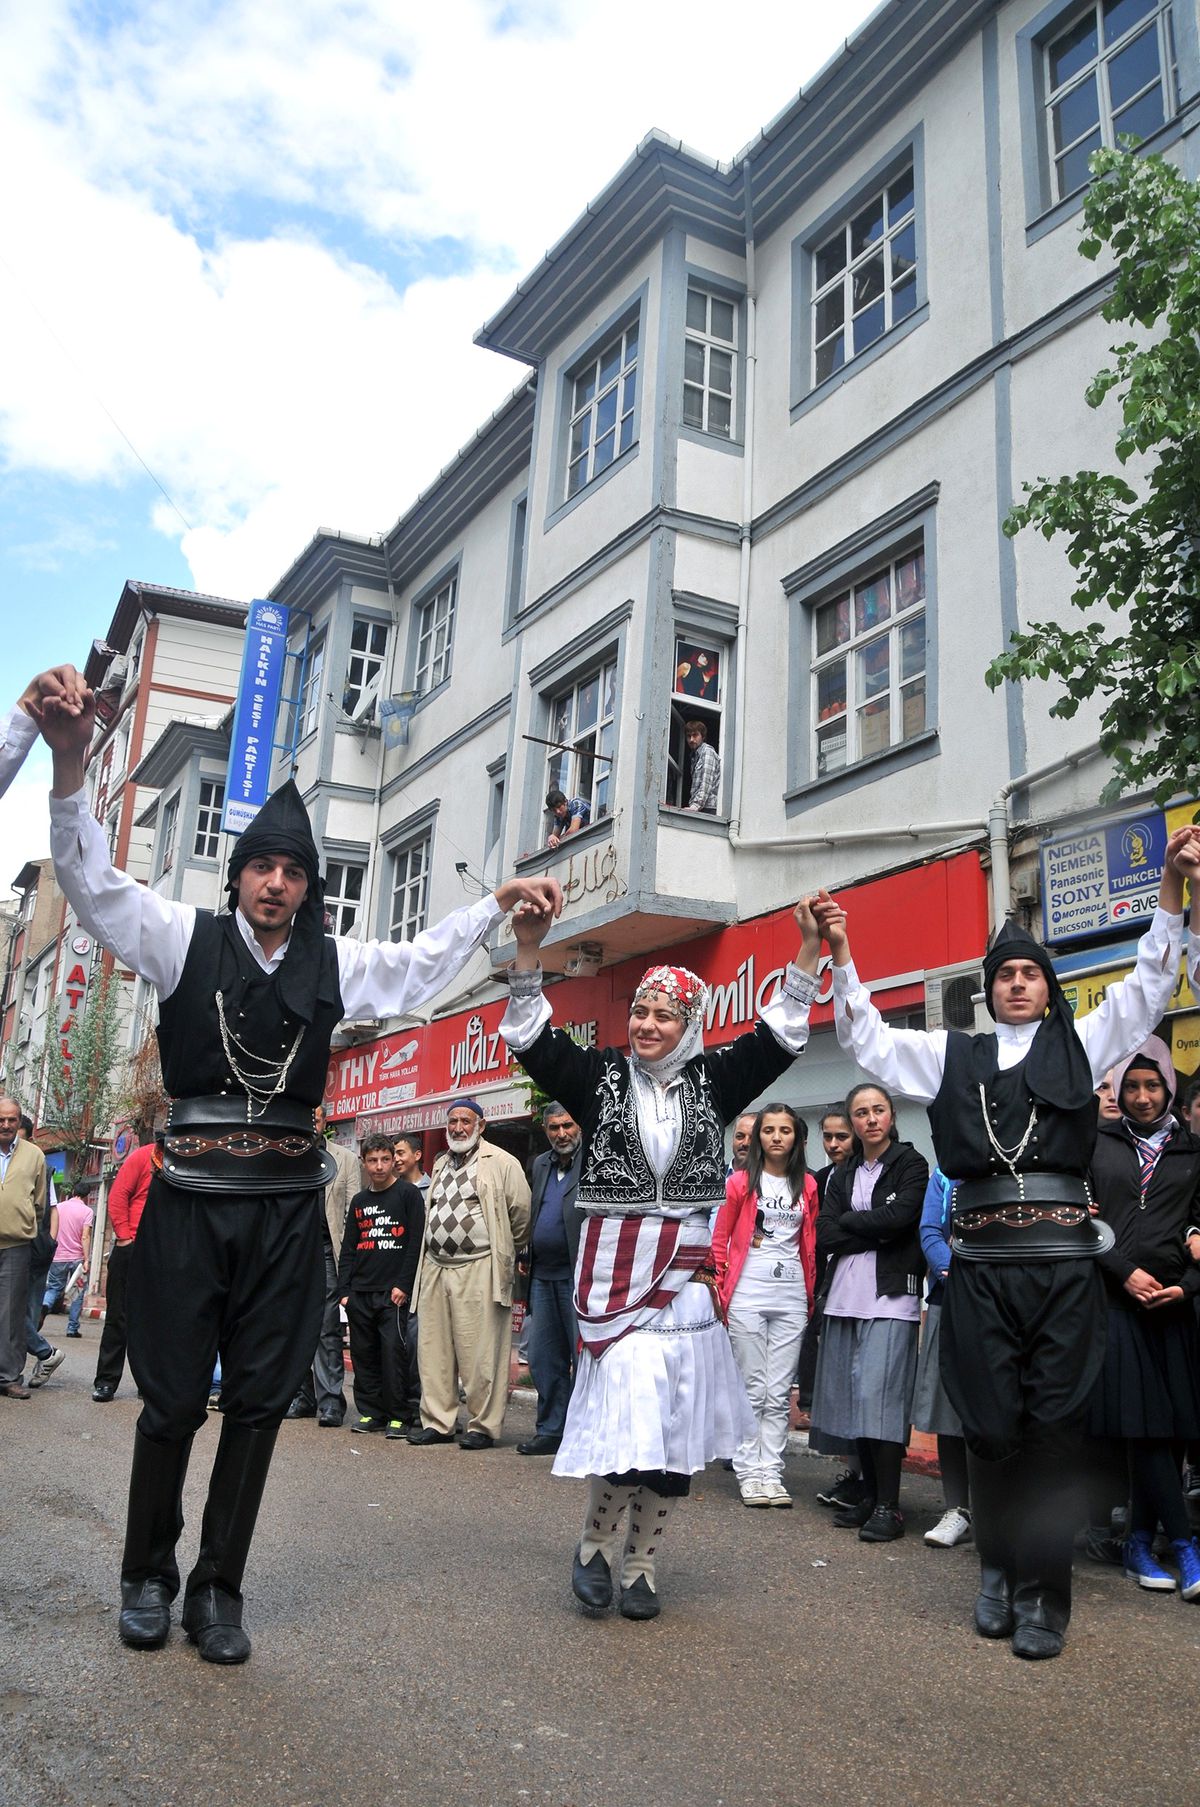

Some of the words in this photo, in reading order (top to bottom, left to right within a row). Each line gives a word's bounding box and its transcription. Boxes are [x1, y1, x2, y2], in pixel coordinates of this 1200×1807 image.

[255, 635, 272, 687] HALKIN
[1048, 837, 1100, 861] NOKIA
[1050, 851, 1103, 876] SIEMENS
[1050, 868, 1104, 890] Panasonic
[1051, 882, 1105, 909] SONY
[1131, 894, 1158, 914] ave
[1062, 902, 1107, 919] MOTOROLA
[1053, 919, 1094, 936] ERICSSON
[339, 1051, 380, 1091] THY
[336, 1095, 361, 1115] GÖKAY
[362, 1091, 377, 1110] TUR
[383, 1115, 401, 1132] YILDIZ
[402, 1108, 423, 1130] PESTİL
[424, 1111, 431, 1127] &
[363, 1206, 385, 1216] YOK...
[375, 1216, 399, 1226] YOK...
[369, 1228, 392, 1237] YOK...
[378, 1240, 402, 1249] YOK...
